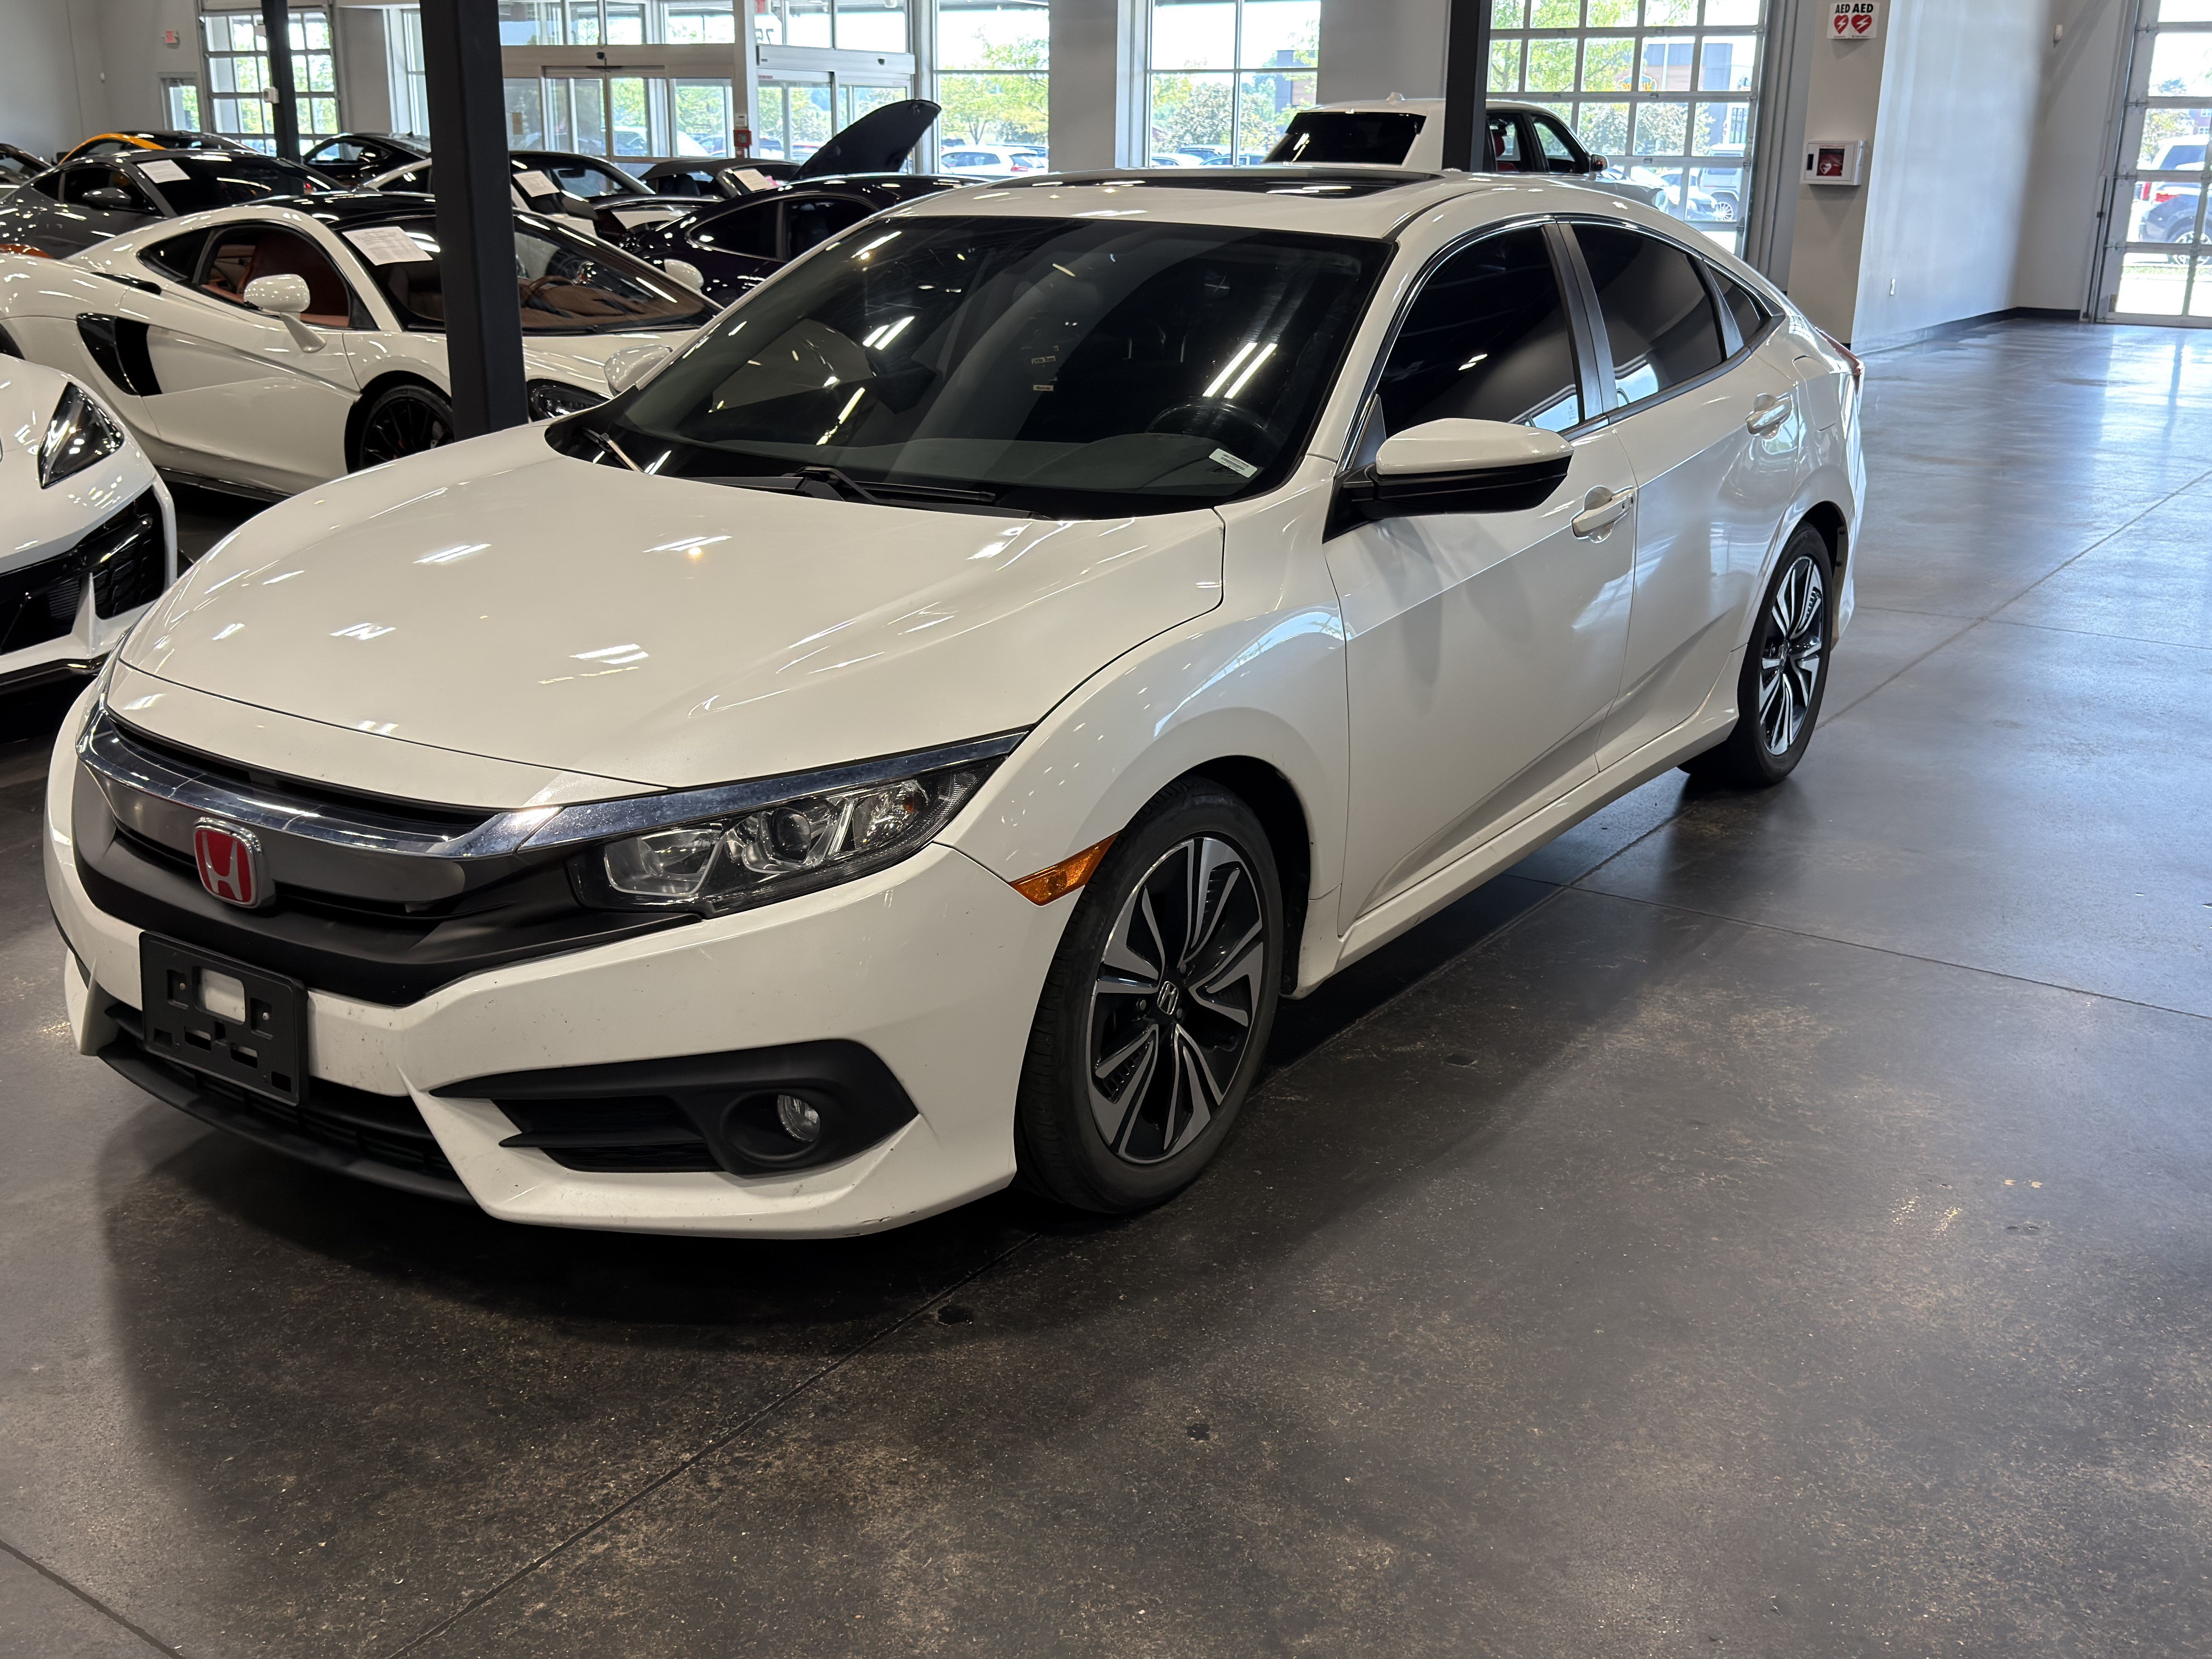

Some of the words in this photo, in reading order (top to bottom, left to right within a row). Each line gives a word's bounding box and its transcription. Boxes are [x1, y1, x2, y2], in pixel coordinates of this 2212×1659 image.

[1835, 4, 1850, 14] AED
[1853, 3, 1874, 13] AED
[202, 831, 243, 901] H
